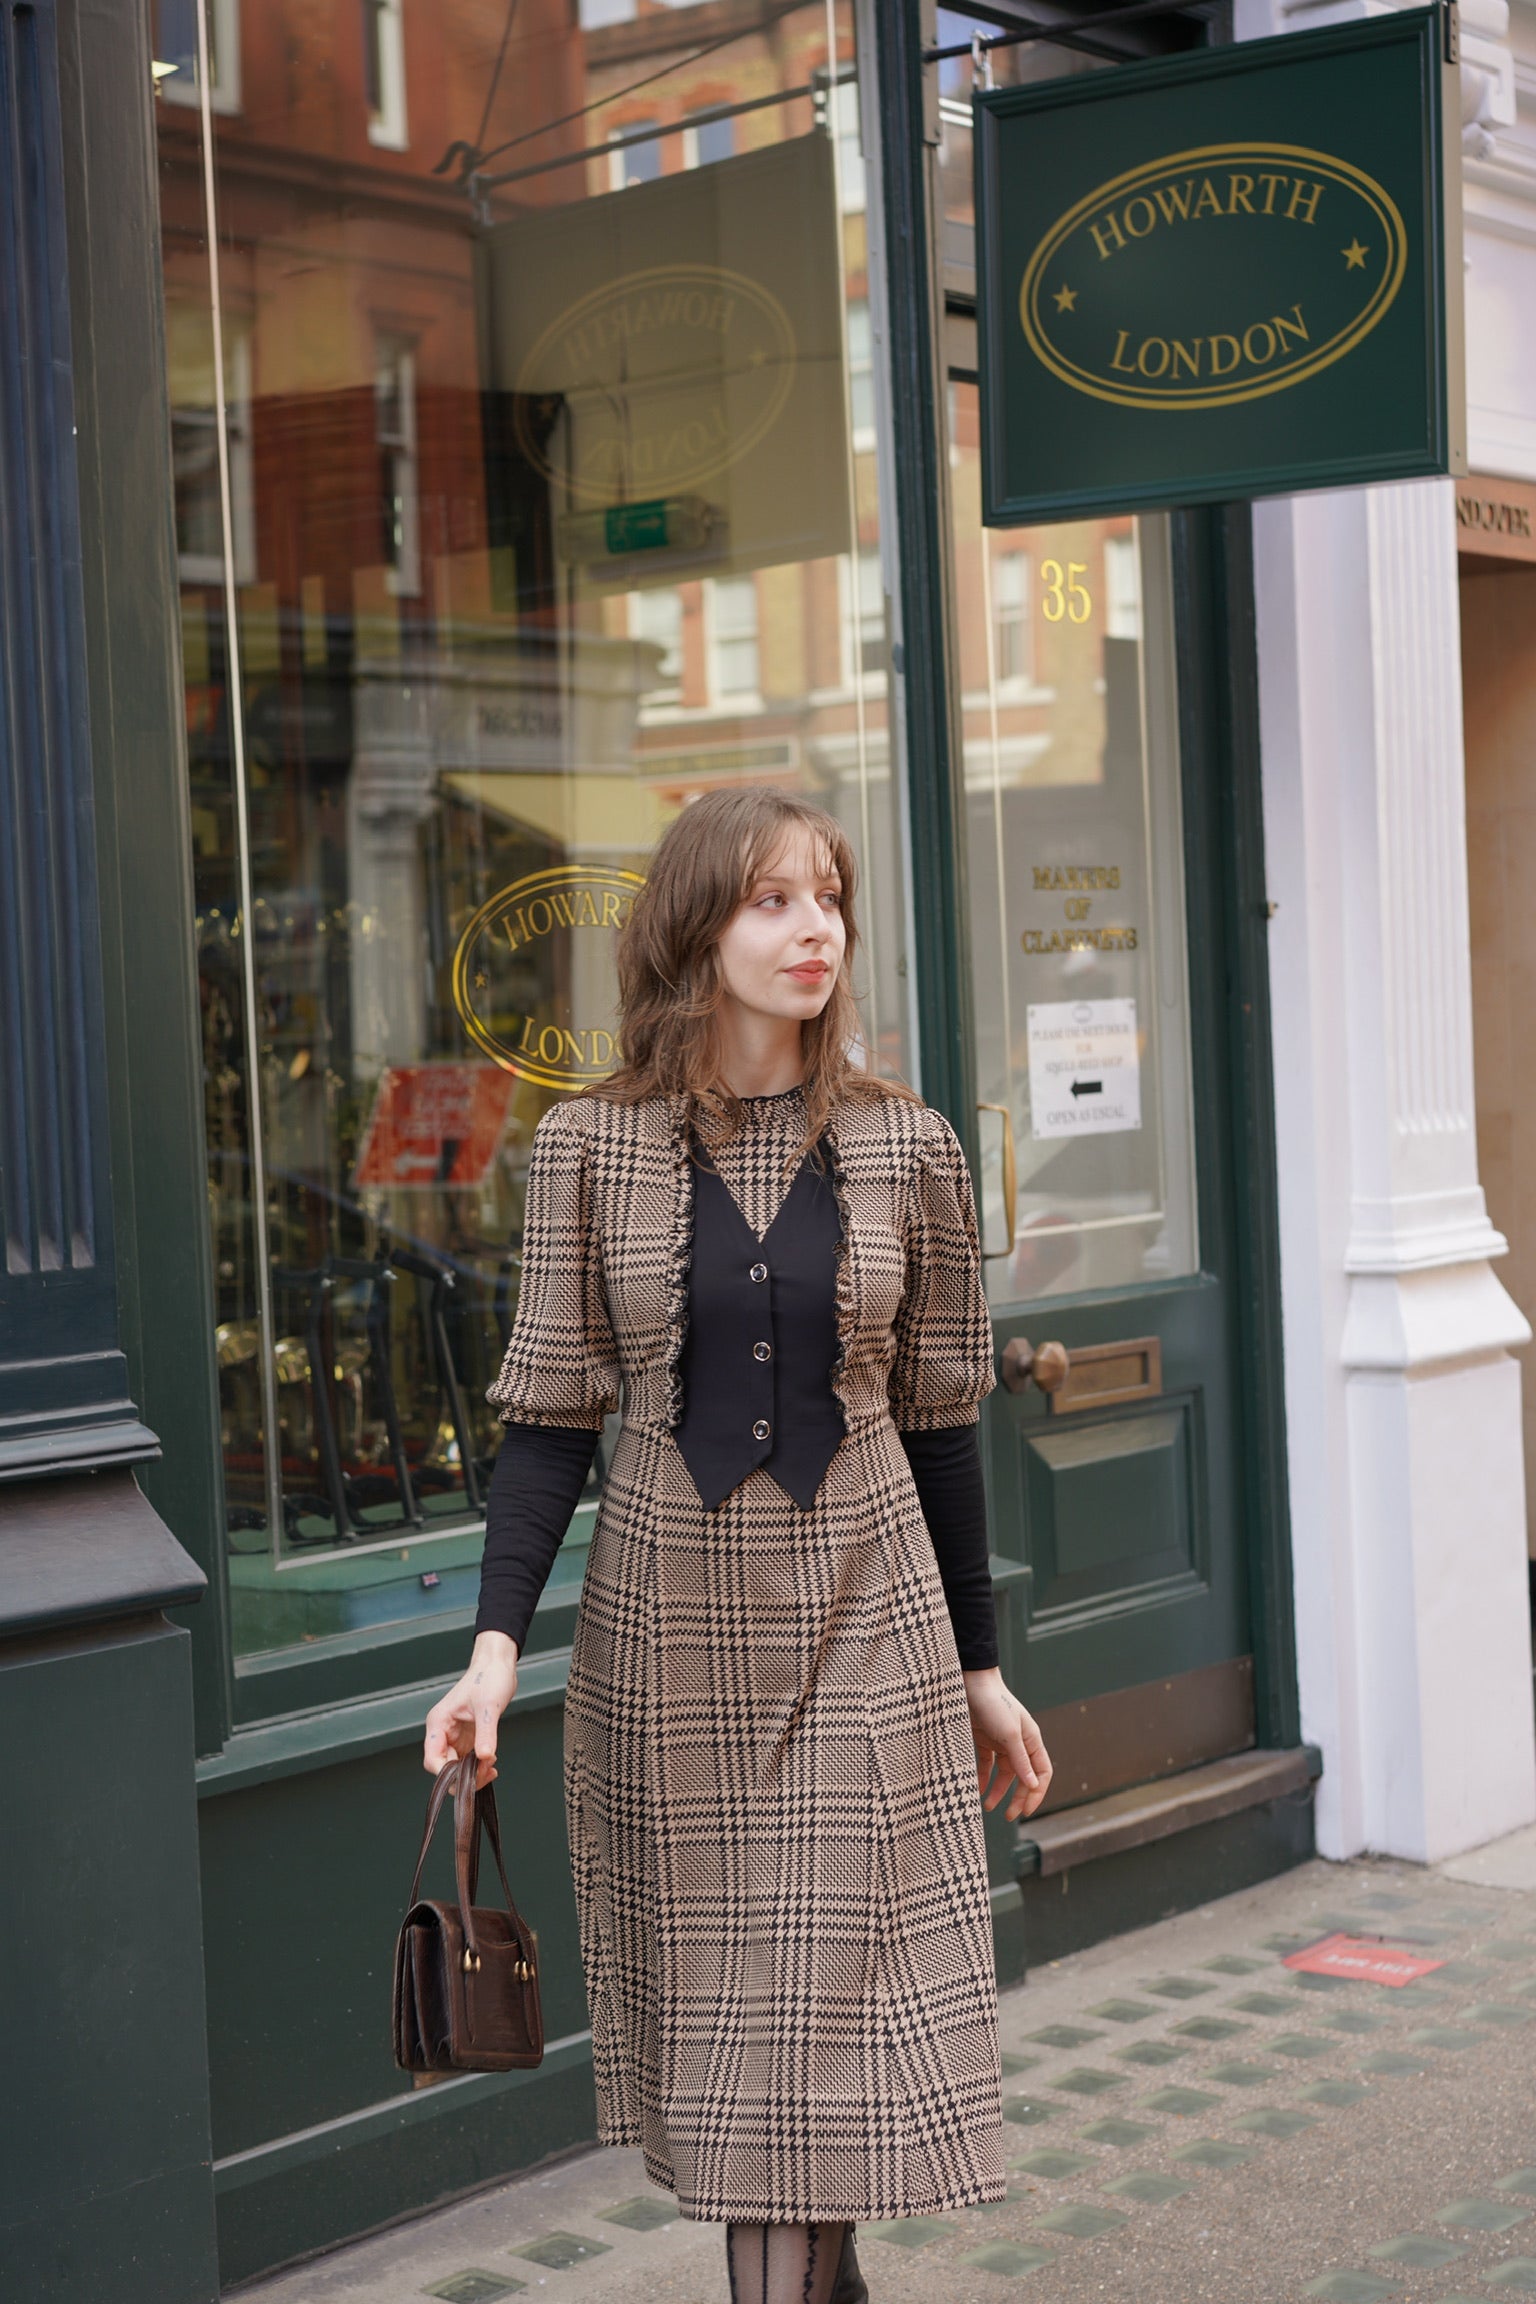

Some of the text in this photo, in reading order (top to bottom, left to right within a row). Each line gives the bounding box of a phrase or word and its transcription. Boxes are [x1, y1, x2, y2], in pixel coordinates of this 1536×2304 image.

[1087, 174, 1325, 261] HOWARTH
[1109, 305, 1310, 379] LONDON
[1041, 559, 1092, 624] 35
[1032, 866, 1119, 890] MAKERS
[502, 890, 637, 951] HOWART
[1064, 897, 1092, 921] OF
[518, 1016, 625, 1066] LOND
